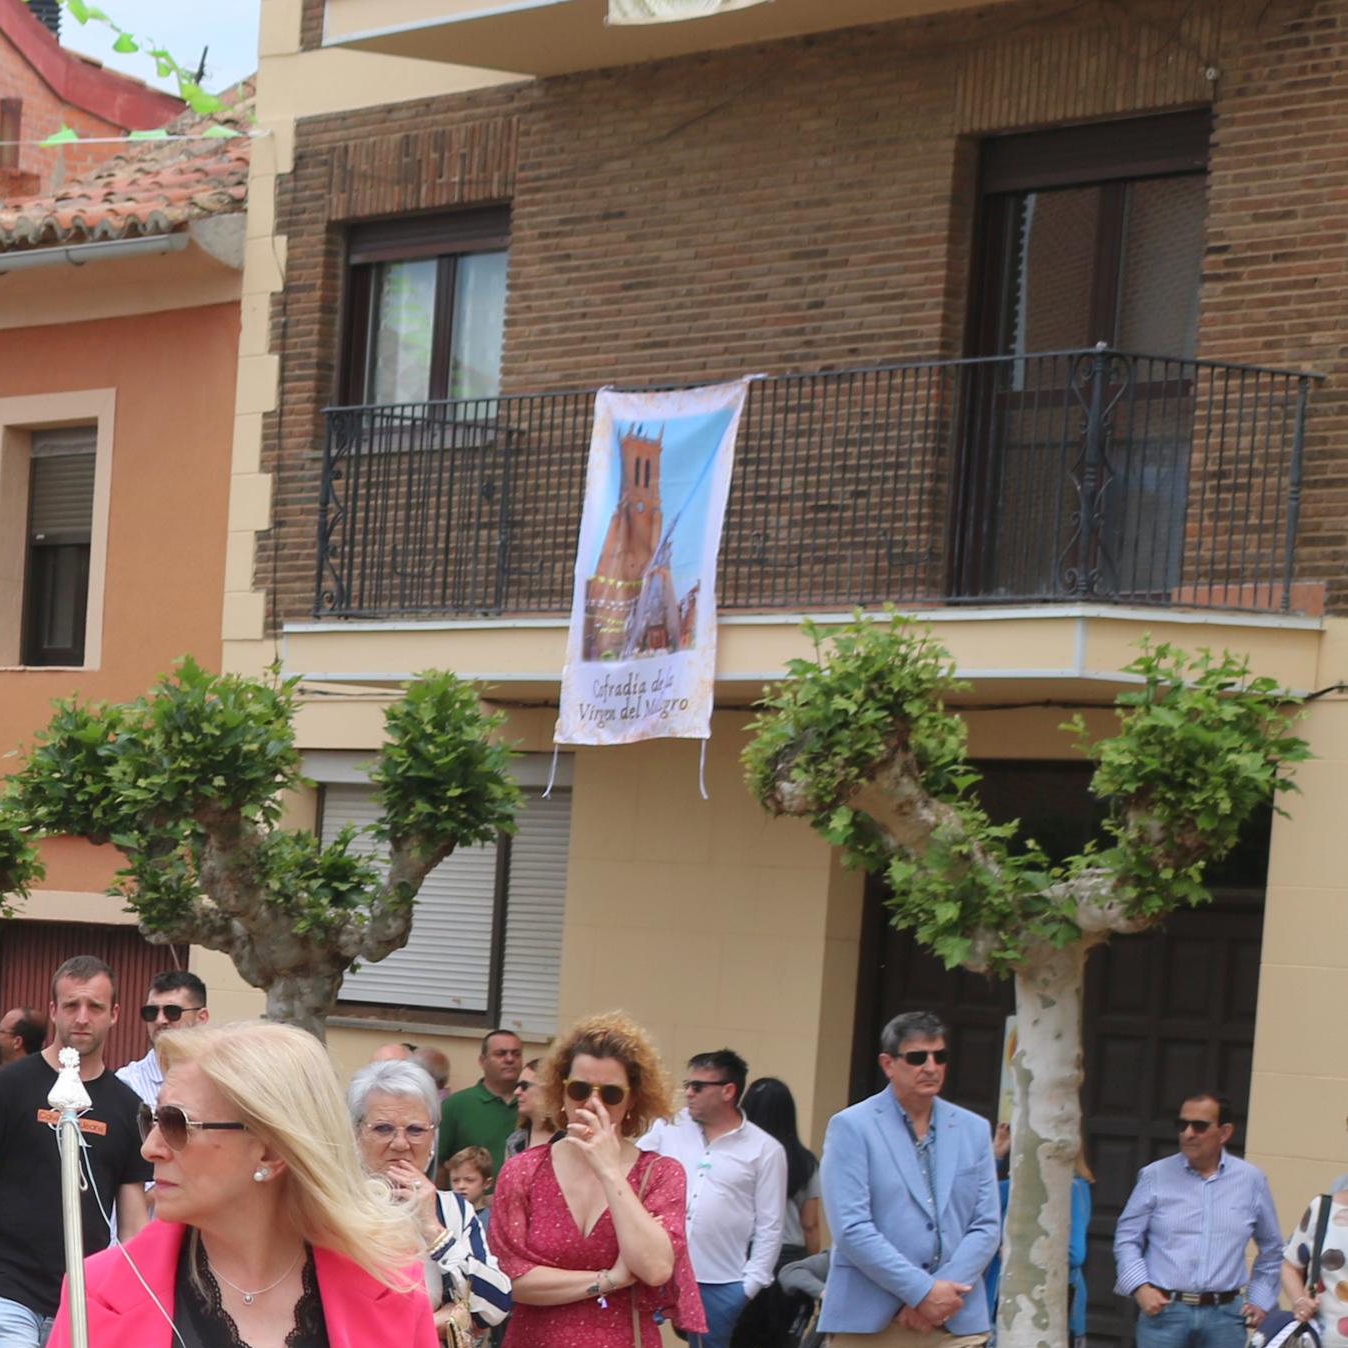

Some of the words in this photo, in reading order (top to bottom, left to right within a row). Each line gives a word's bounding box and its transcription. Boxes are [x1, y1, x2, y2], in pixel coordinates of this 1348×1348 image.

[592, 672, 646, 703] Cofradía
[579, 703, 616, 728] Virgen
[620, 695, 643, 720] del
